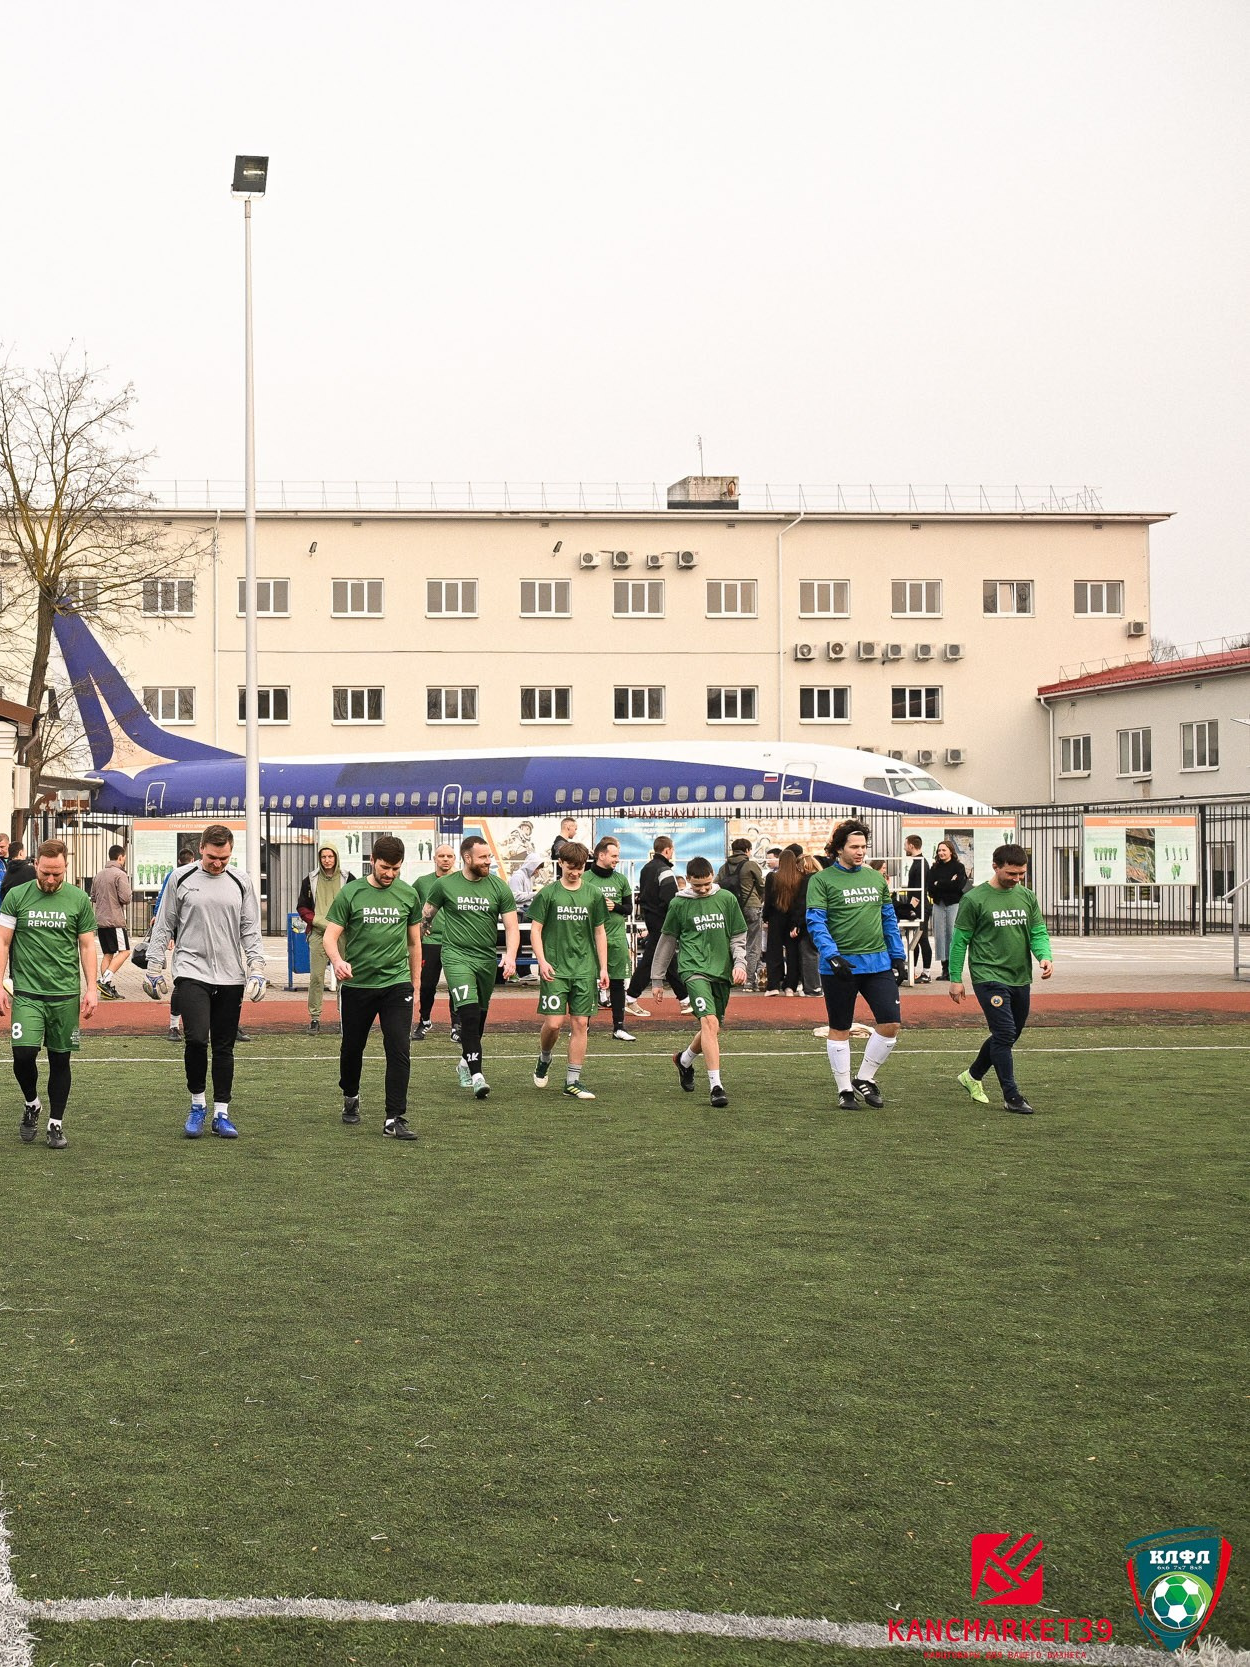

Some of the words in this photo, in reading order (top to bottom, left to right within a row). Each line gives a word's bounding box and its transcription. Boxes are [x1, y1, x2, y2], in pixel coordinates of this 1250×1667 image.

[843, 886, 878, 897] BALTIA
[457, 896, 489, 905] BALTIA
[845, 895, 880, 904] REMONT
[363, 907, 400, 916] BALTIA
[457, 904, 490, 912] REMONT
[557, 905, 588, 914] BALTIA
[28, 910, 67, 920] BALTIA
[693, 913, 724, 924] BALTIA
[992, 909, 1027, 919] BALTIA
[28, 919, 67, 928] REMONT
[363, 916, 400, 924] REMONT
[994, 918, 1027, 927] REMONT
[695, 922, 725, 932] REMONT
[452, 984, 469, 1002] 17
[541, 995, 560, 1010] 30
[695, 996, 707, 1012] 9
[12, 1022, 23, 1039] 8
